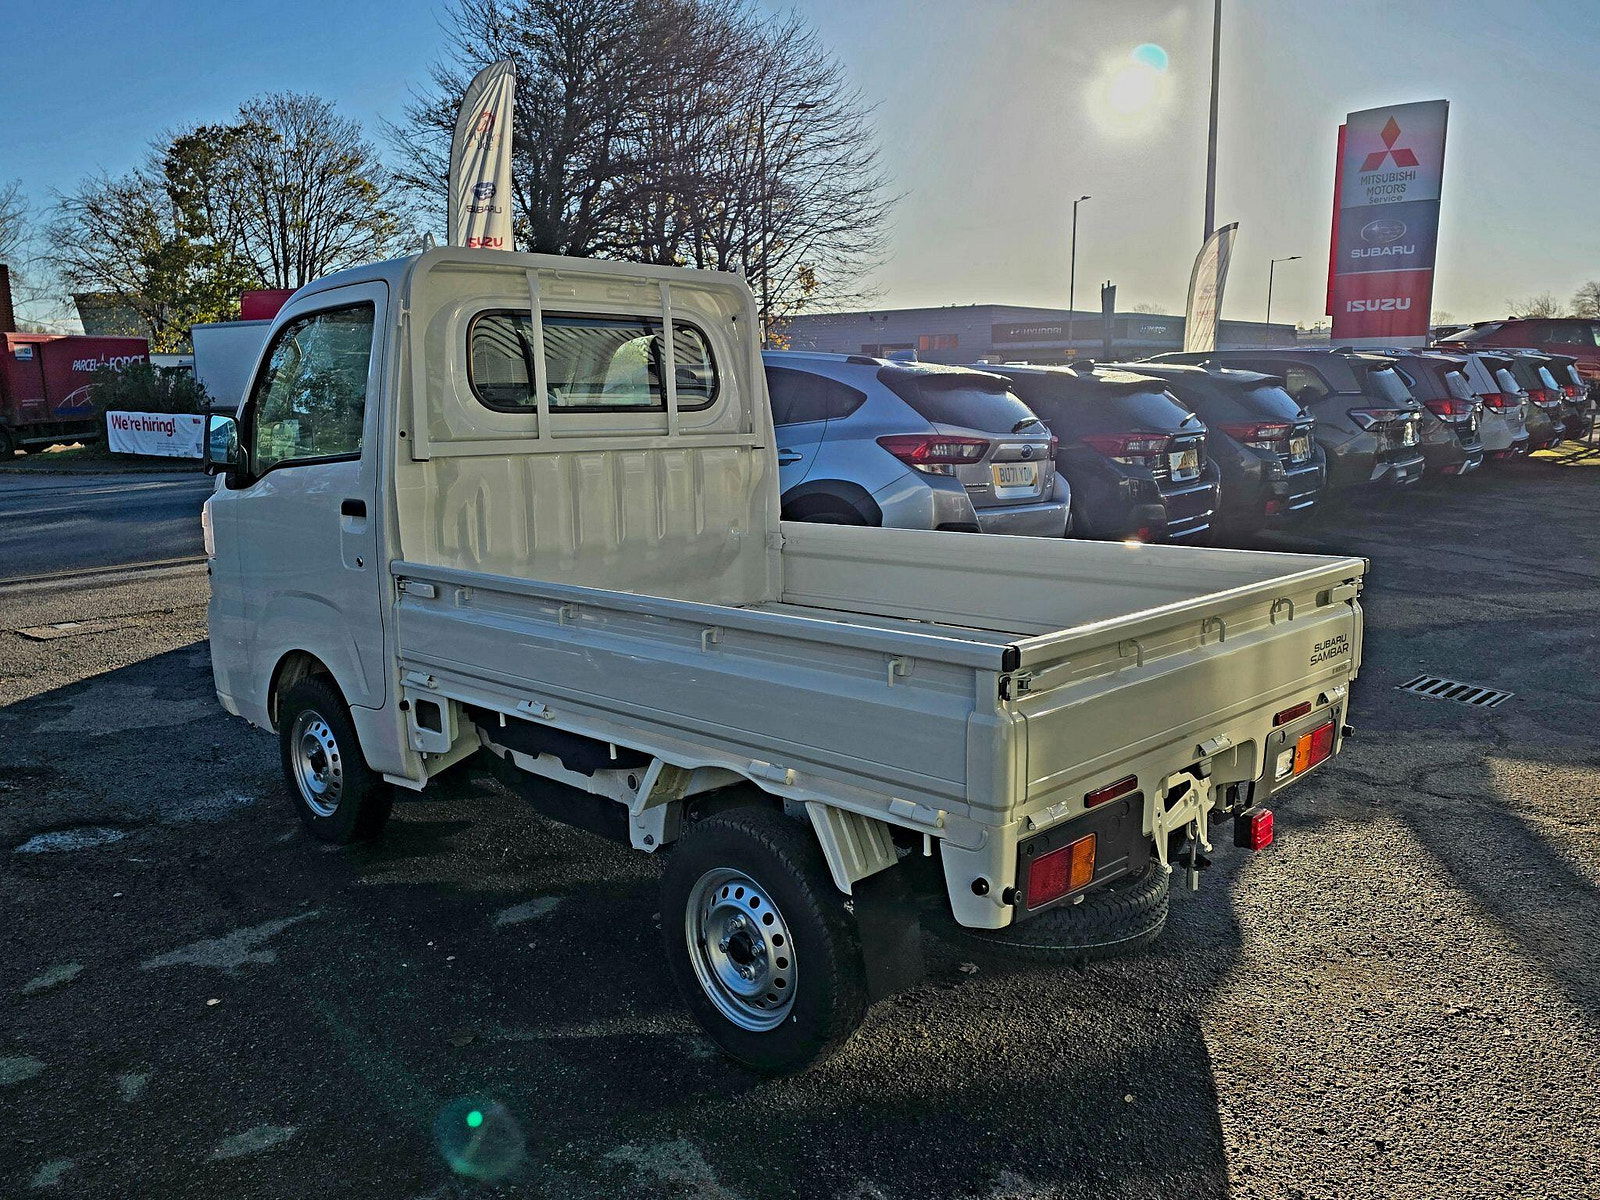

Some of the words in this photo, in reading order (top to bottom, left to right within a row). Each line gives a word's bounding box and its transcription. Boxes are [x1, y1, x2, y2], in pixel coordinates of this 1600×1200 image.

[1360, 170, 1416, 186] MITSUBISHI
[1366, 184, 1407, 197] MOTORS
[1369, 195, 1403, 204] Service
[1351, 245, 1415, 258] SUBARU
[1346, 298, 1411, 312] ISUZU
[72, 359, 98, 371] PARCEL
[111, 415, 141, 431] We're
[141, 416, 176, 437] hiring!
[1314, 633, 1347, 653] SUBARU
[1310, 642, 1349, 666] SAMBAR
